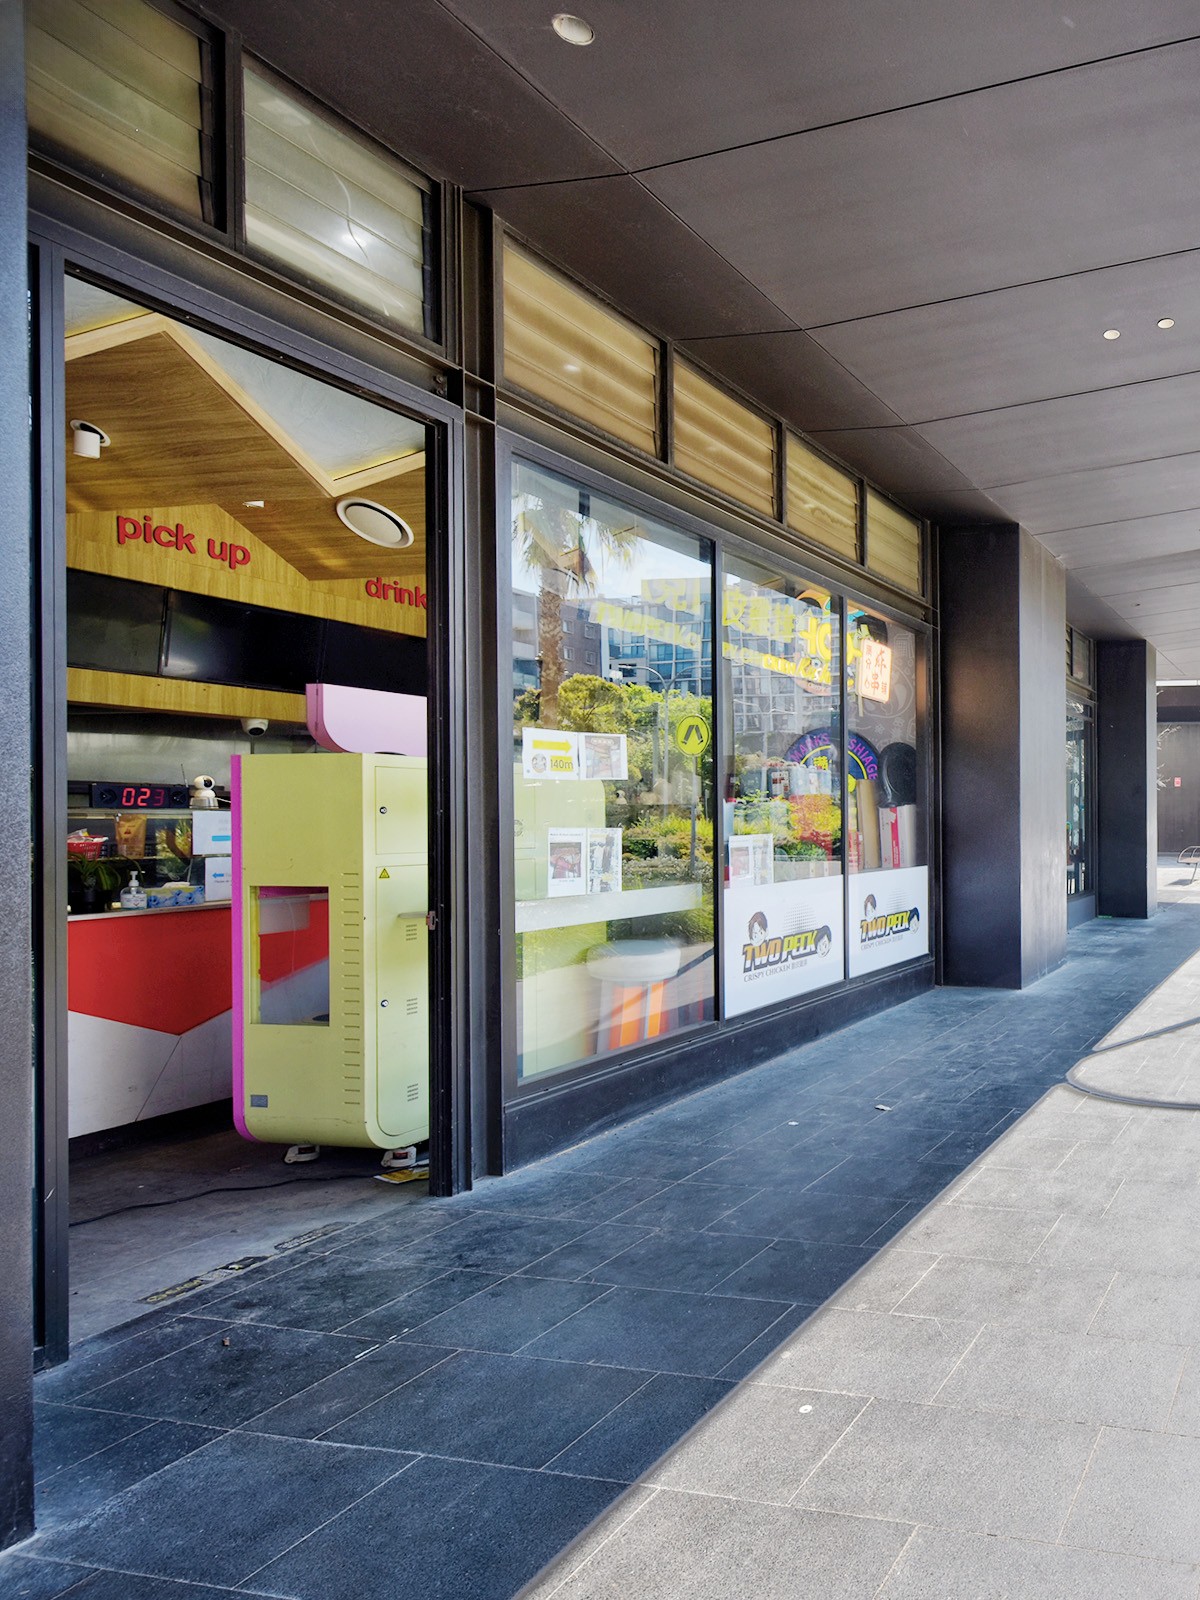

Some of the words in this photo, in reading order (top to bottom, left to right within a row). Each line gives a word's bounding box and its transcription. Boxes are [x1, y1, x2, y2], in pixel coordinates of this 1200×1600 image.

[116, 515, 196, 554] pick
[208, 538, 251, 569] up
[550, 759, 574, 769] 140m
[847, 738, 879, 780] SHIAGE
[122, 787, 165, 807] 023
[860, 915, 887, 943] TWO
[743, 937, 782, 973] TWO
[780, 930, 819, 963] PECK
[743, 970, 765, 983] CRISPY
[765, 963, 791, 977] CHICKEN
